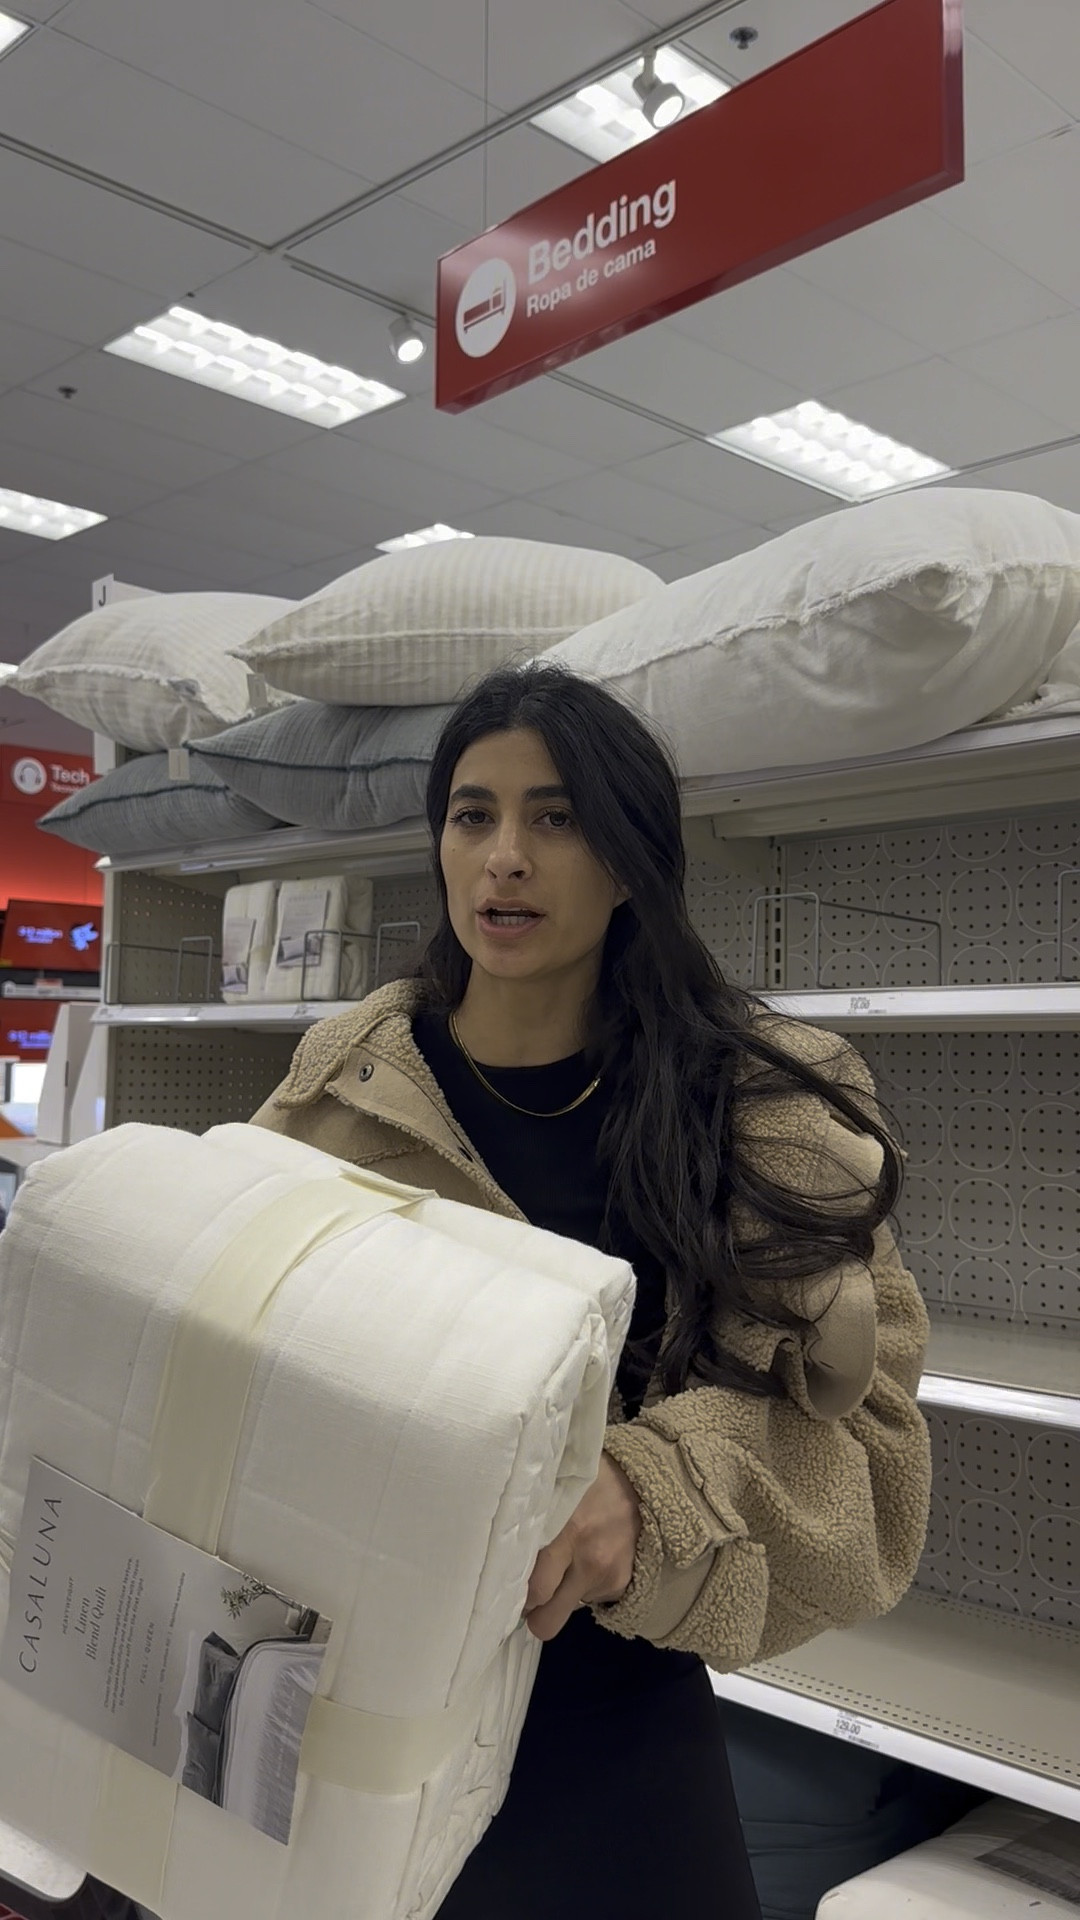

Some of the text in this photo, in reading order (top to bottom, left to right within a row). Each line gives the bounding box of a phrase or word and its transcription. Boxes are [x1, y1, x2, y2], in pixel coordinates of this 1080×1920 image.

[528, 179, 676, 284] Bedding
[526, 239, 656, 318] Ropa de cama
[98, 585, 107, 607] J
[50, 764, 90, 785] Tech
[19, 1498, 62, 1673] CASALUNA
[75, 1597, 91, 1634] Linen
[86, 1586, 106, 1659] Blend Quilt
[139, 1663, 147, 1683] FULL
[145, 1622, 154, 1653] QUEEN
